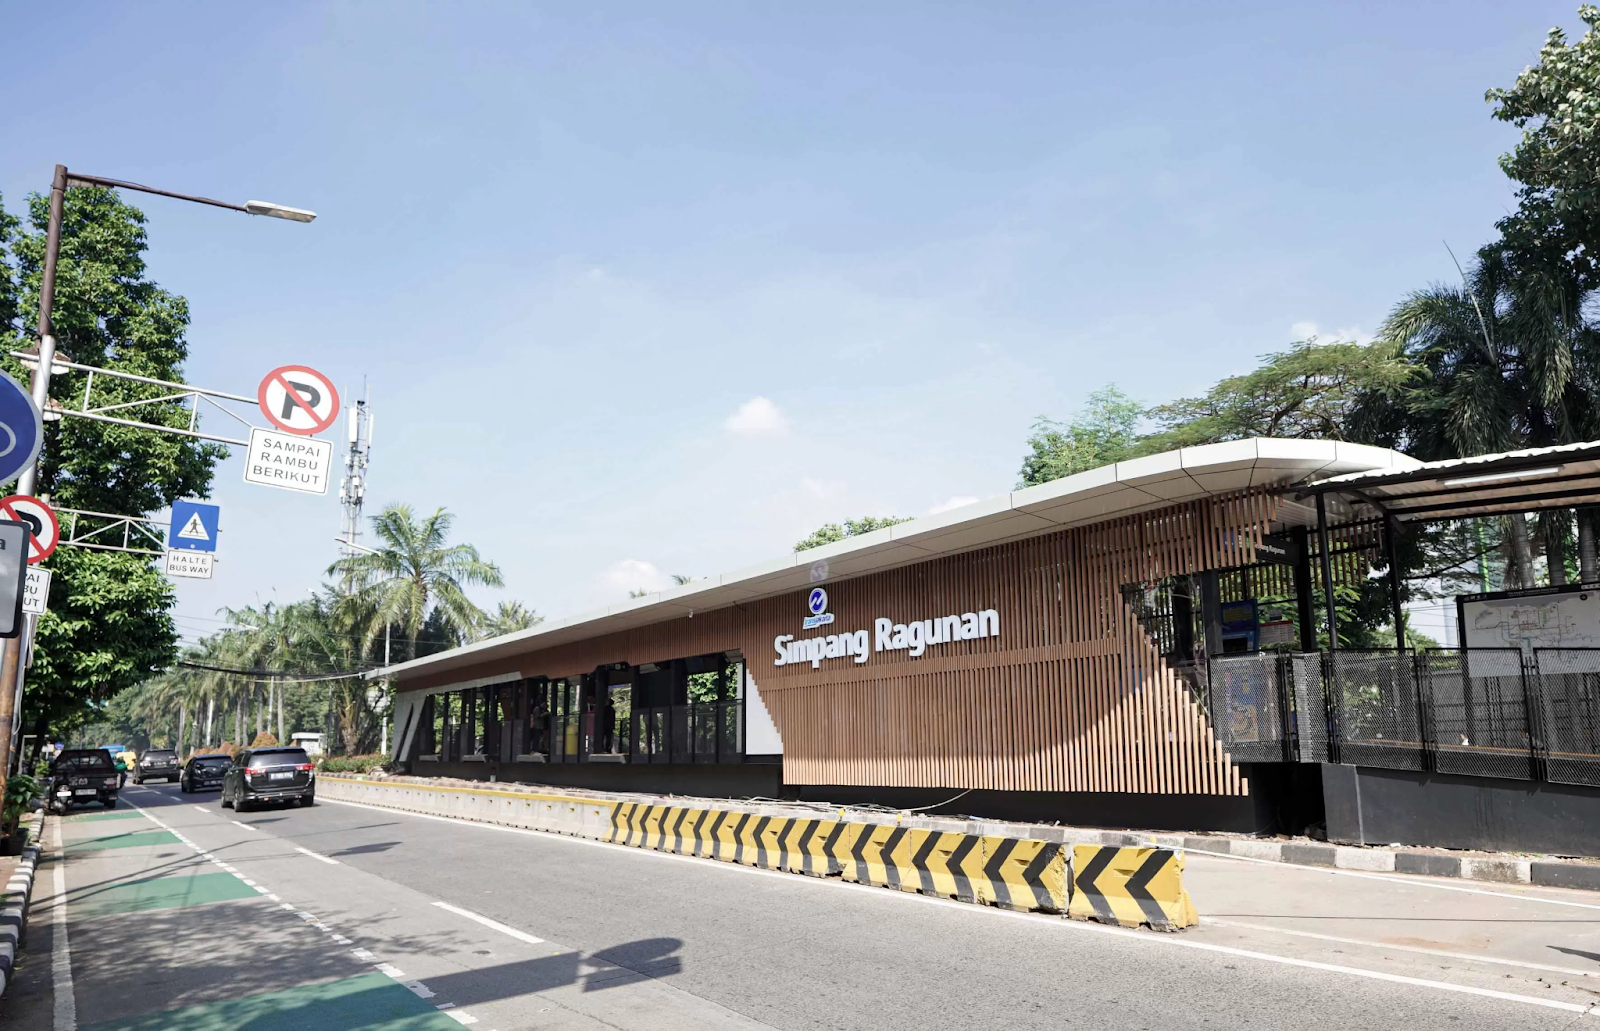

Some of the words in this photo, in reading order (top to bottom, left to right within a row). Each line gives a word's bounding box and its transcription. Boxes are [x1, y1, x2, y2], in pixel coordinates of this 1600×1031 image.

[281, 380, 321, 420] P
[263, 438, 320, 457] SAMPAI
[261, 452, 318, 470] RAMBU
[253, 465, 320, 485] BERIKUT
[169, 564, 187, 572] BUS
[189, 566, 209, 574] WAY
[173, 555, 207, 565] HALTE
[773, 629, 869, 668] Simpang
[874, 608, 1000, 657] Ragunan
